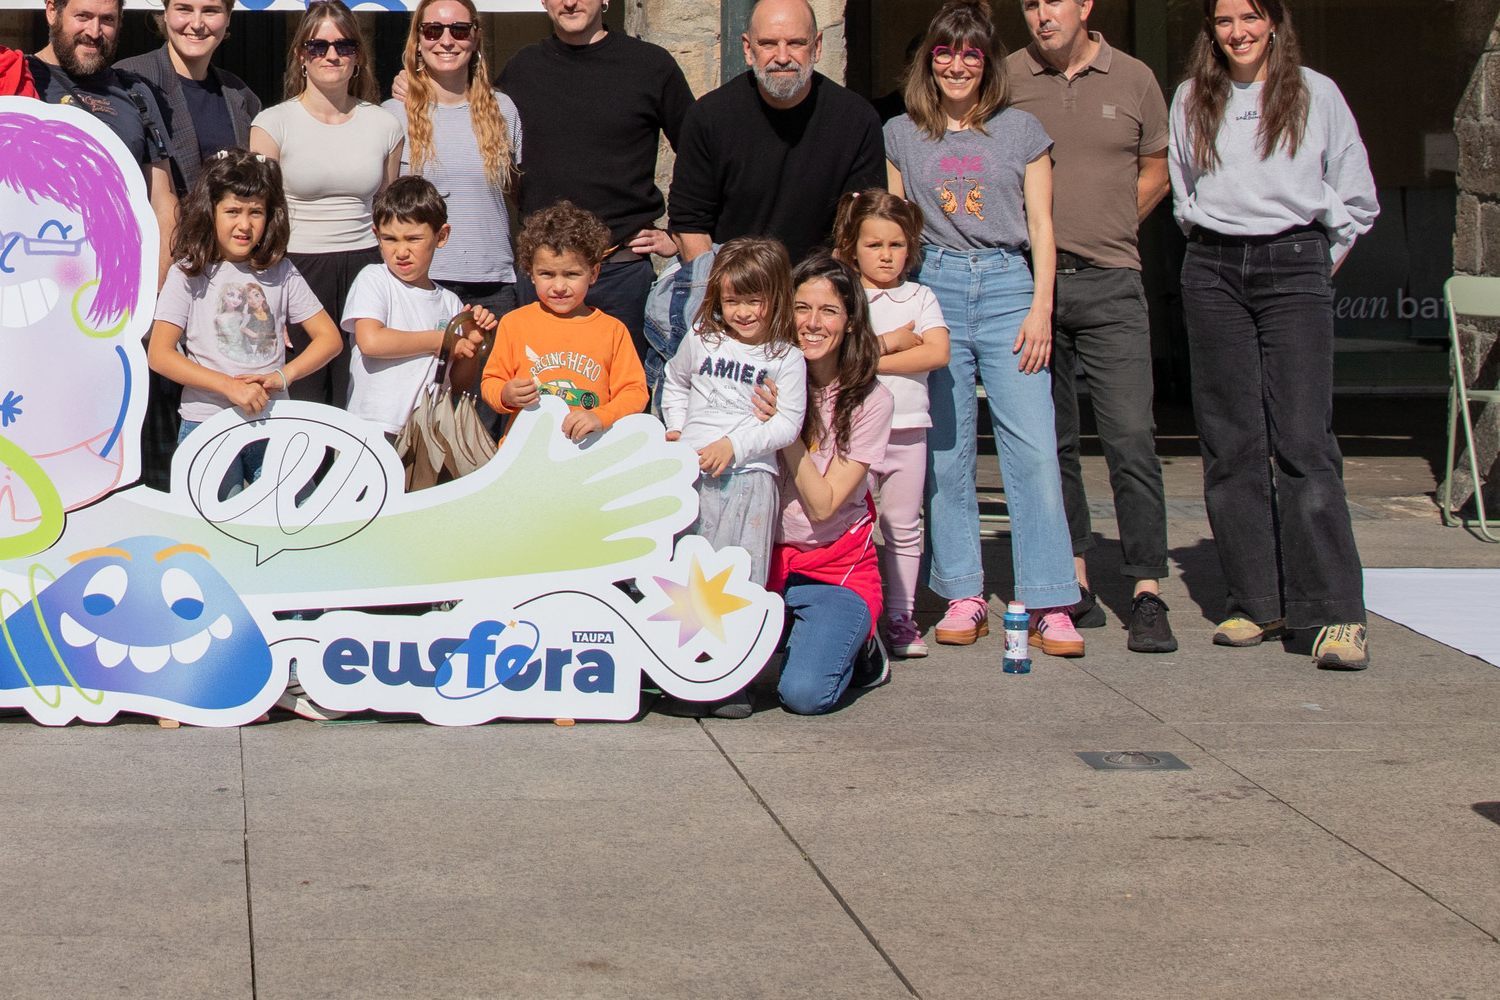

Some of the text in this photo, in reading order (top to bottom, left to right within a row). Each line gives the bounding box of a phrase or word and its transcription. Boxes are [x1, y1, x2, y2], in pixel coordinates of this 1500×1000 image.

[529, 351, 602, 383] RACING HERO
[573, 632, 613, 644] TAUPA
[322, 619, 616, 696] eusfera
